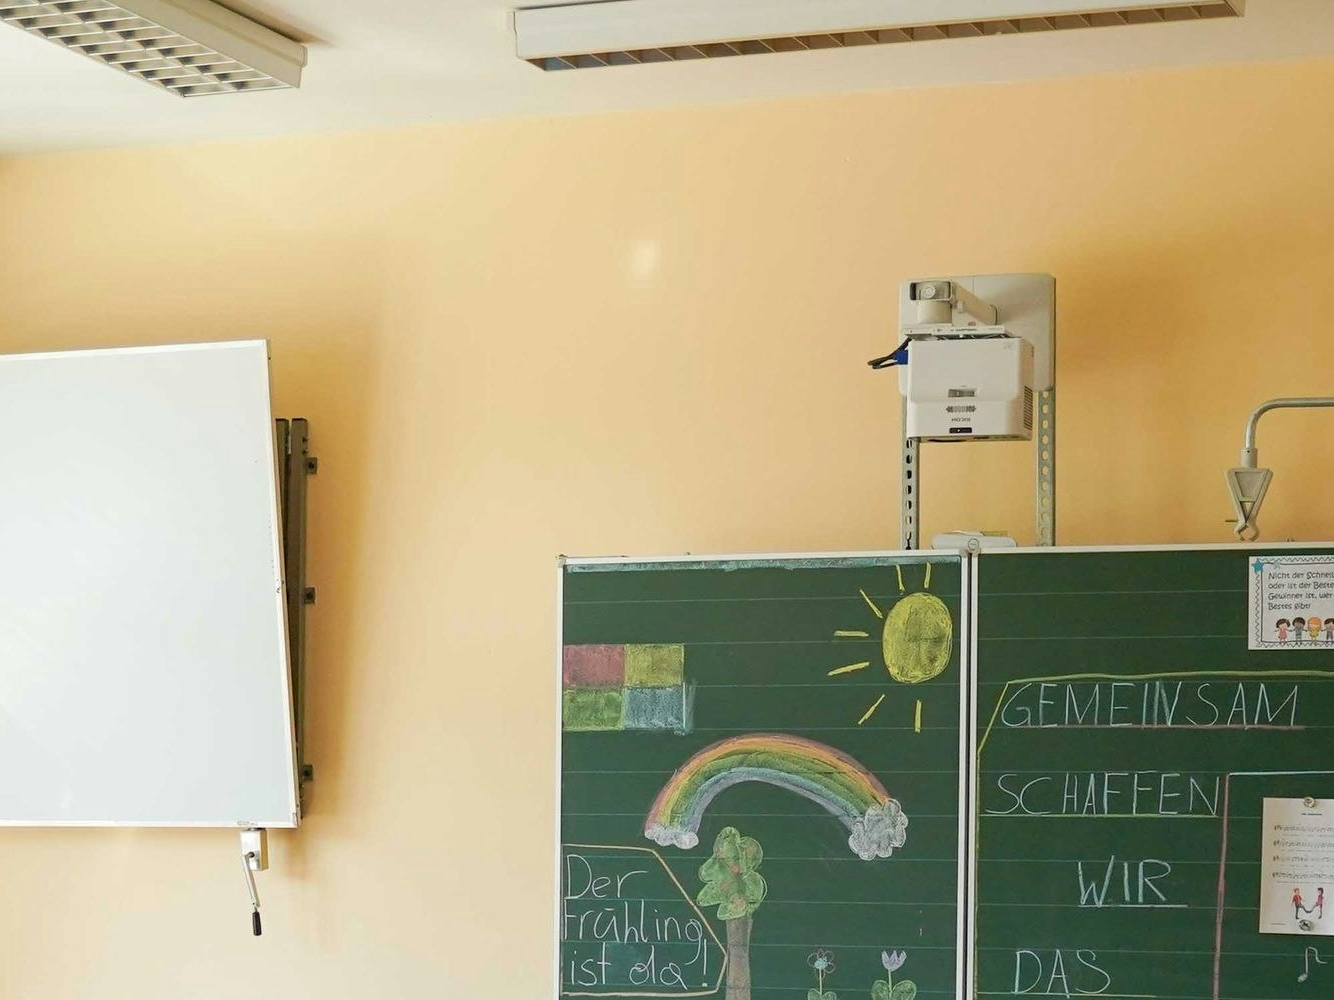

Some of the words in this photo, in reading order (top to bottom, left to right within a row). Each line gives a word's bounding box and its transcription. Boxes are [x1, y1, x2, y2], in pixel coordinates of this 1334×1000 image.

[1001, 681, 1299, 728] GEMEINSAM
[985, 772, 1221, 816] SCHAFFEN
[565, 854, 649, 900] Der
[1077, 855, 1172, 907] WIR
[571, 942, 611, 986] ist
[1012, 949, 1112, 999] DAS
